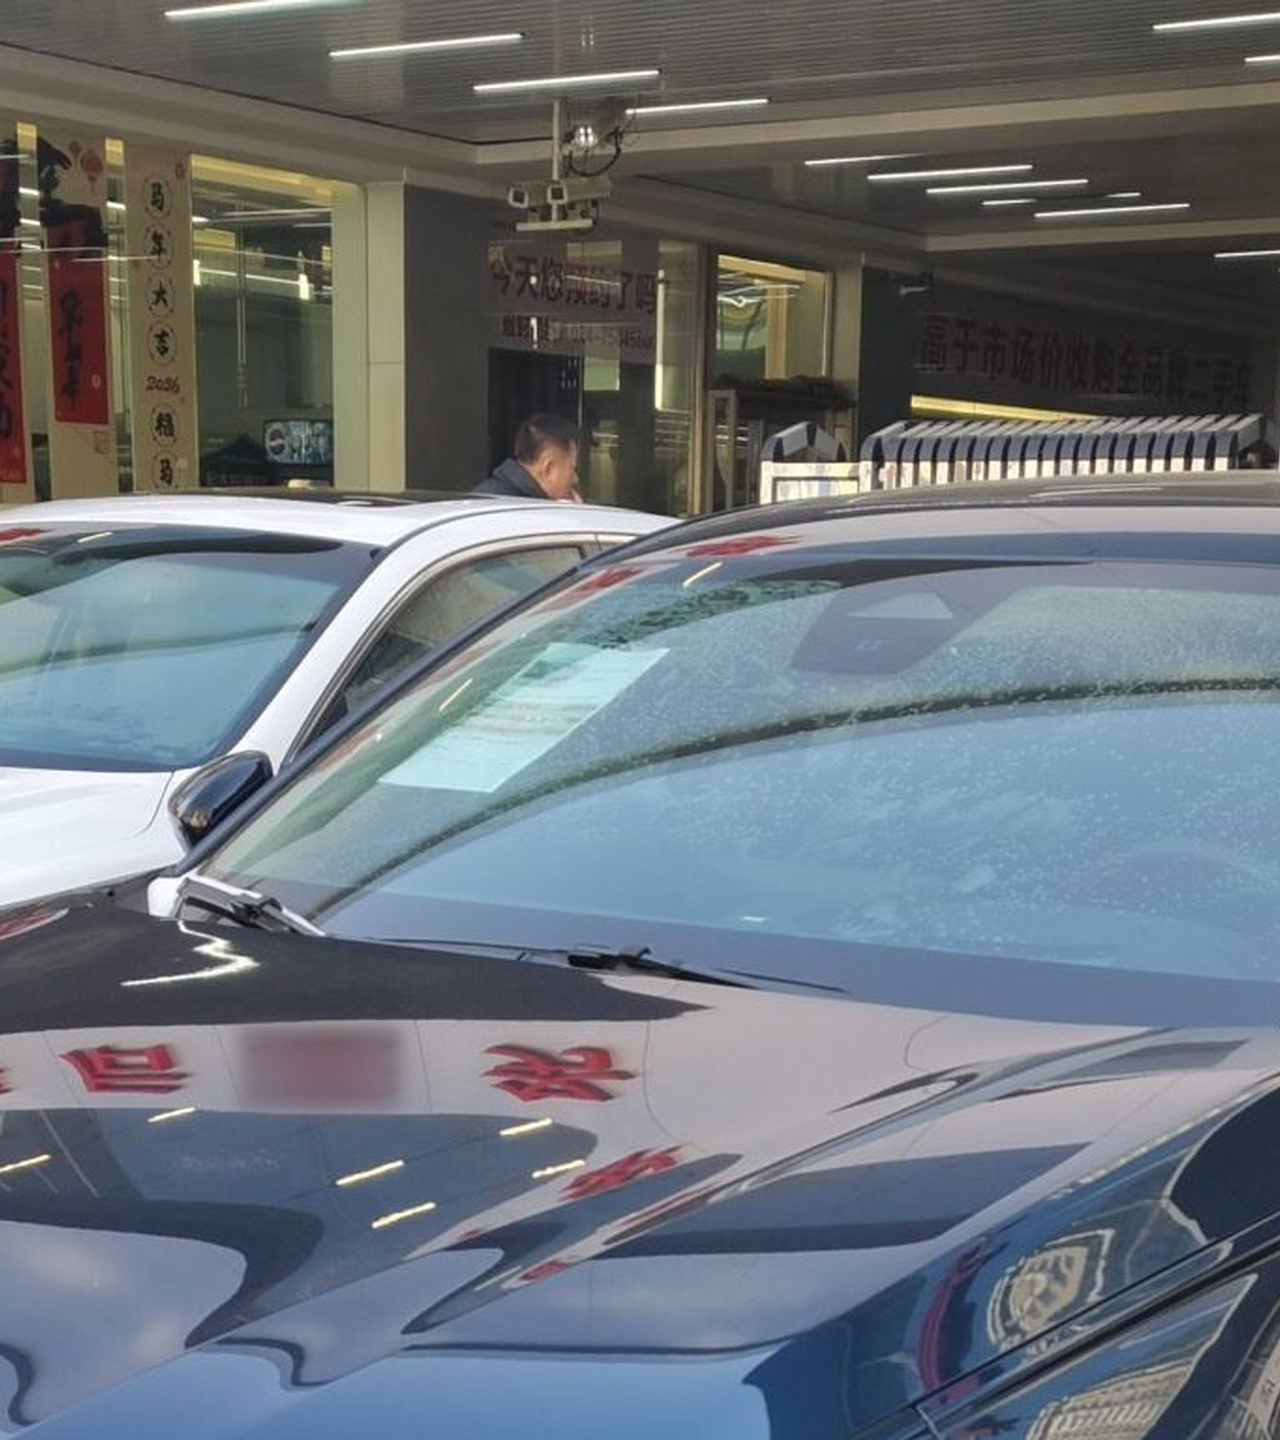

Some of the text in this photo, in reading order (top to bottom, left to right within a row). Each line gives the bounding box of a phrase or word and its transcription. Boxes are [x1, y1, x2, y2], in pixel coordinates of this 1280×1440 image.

[150, 181, 171, 356] 马年大吉
[145, 375, 181, 394] 2026
